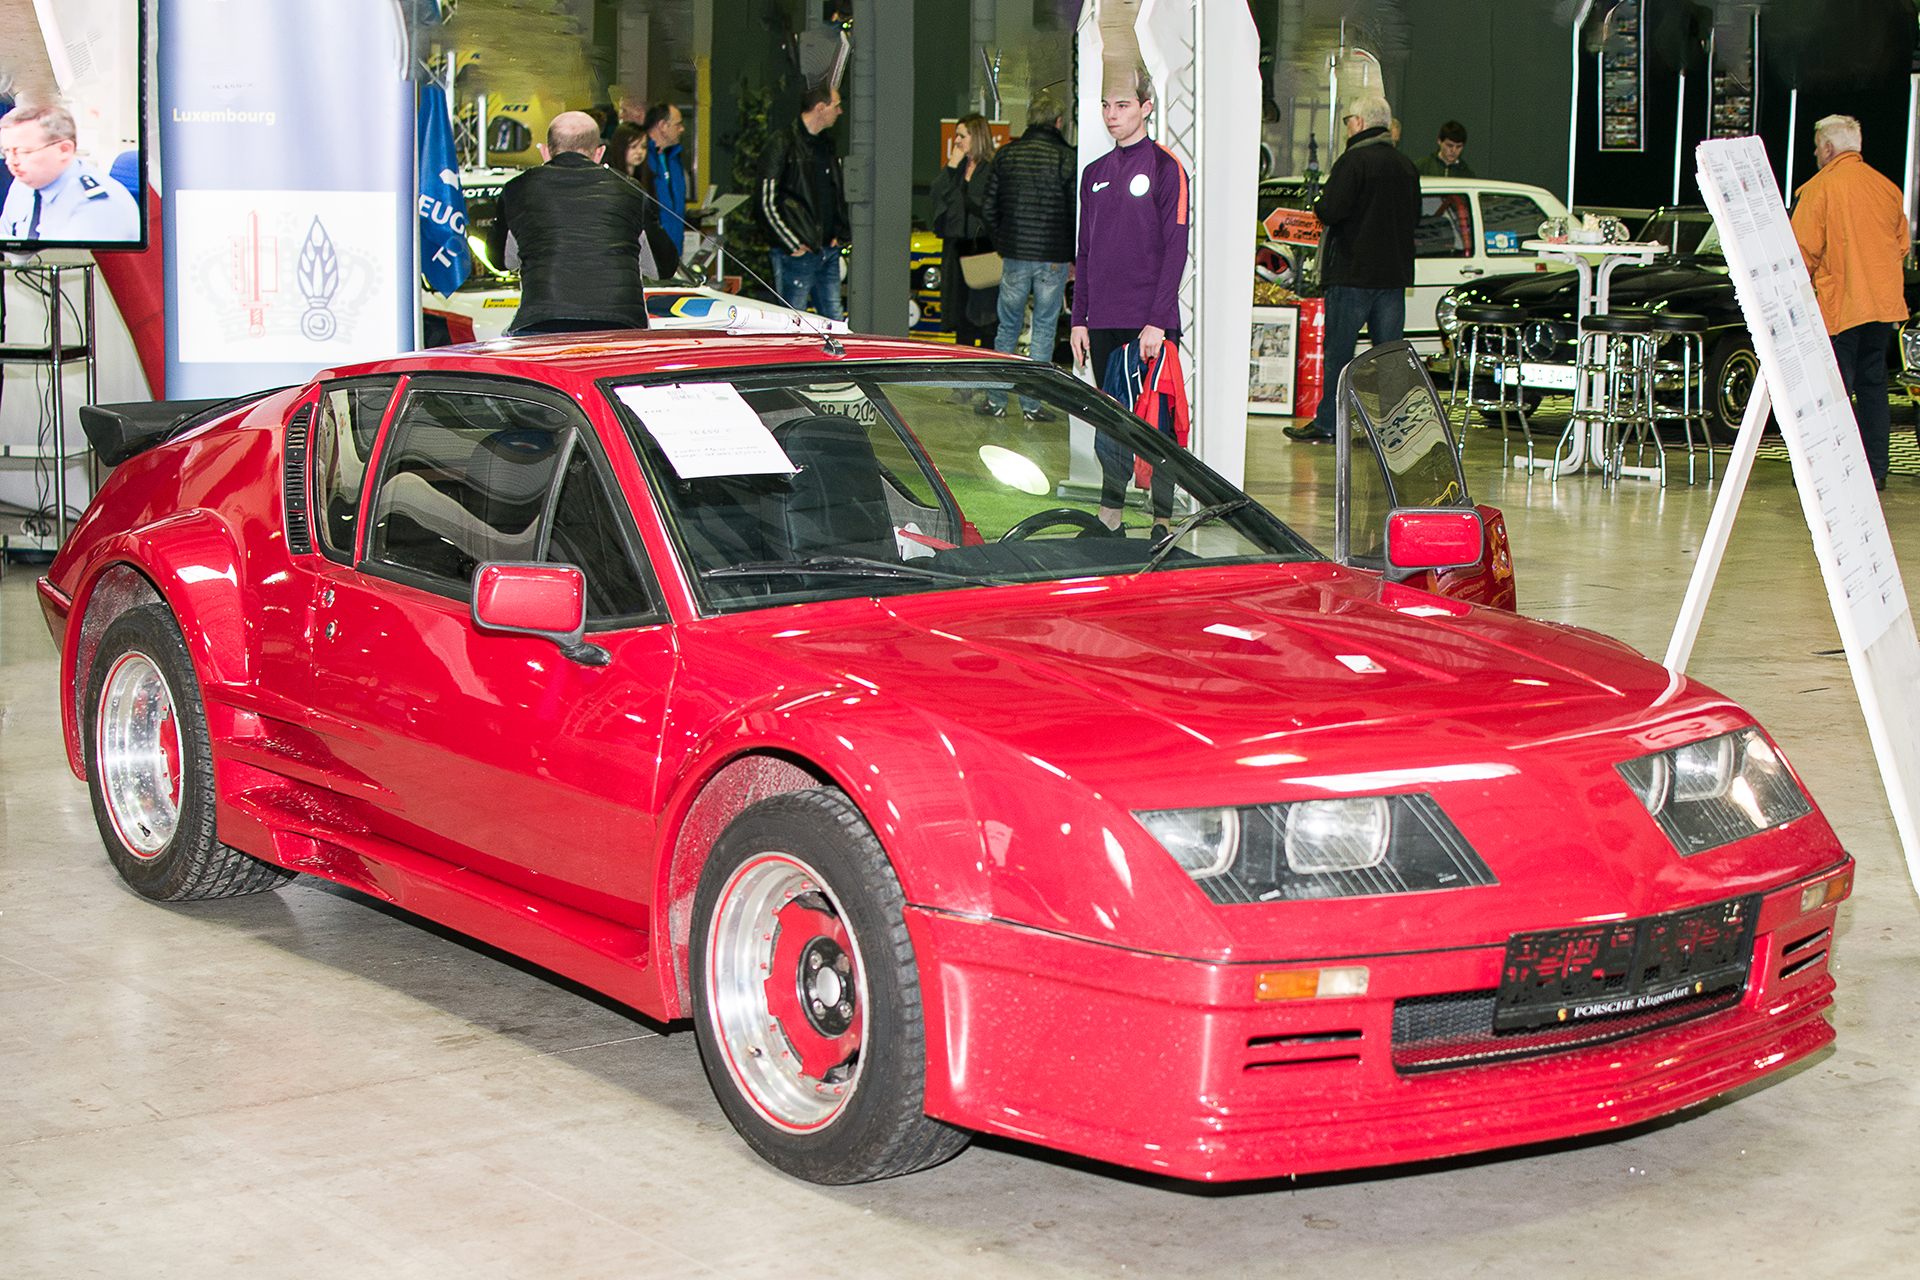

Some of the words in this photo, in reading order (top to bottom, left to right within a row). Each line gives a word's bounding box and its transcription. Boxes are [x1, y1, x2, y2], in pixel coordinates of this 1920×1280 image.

[173, 107, 276, 126] Luxembourg
[462, 187, 485, 199] OT
[1573, 998, 1635, 1018] PORSCHE
[1635, 986, 1690, 1008] Klagenfurt
